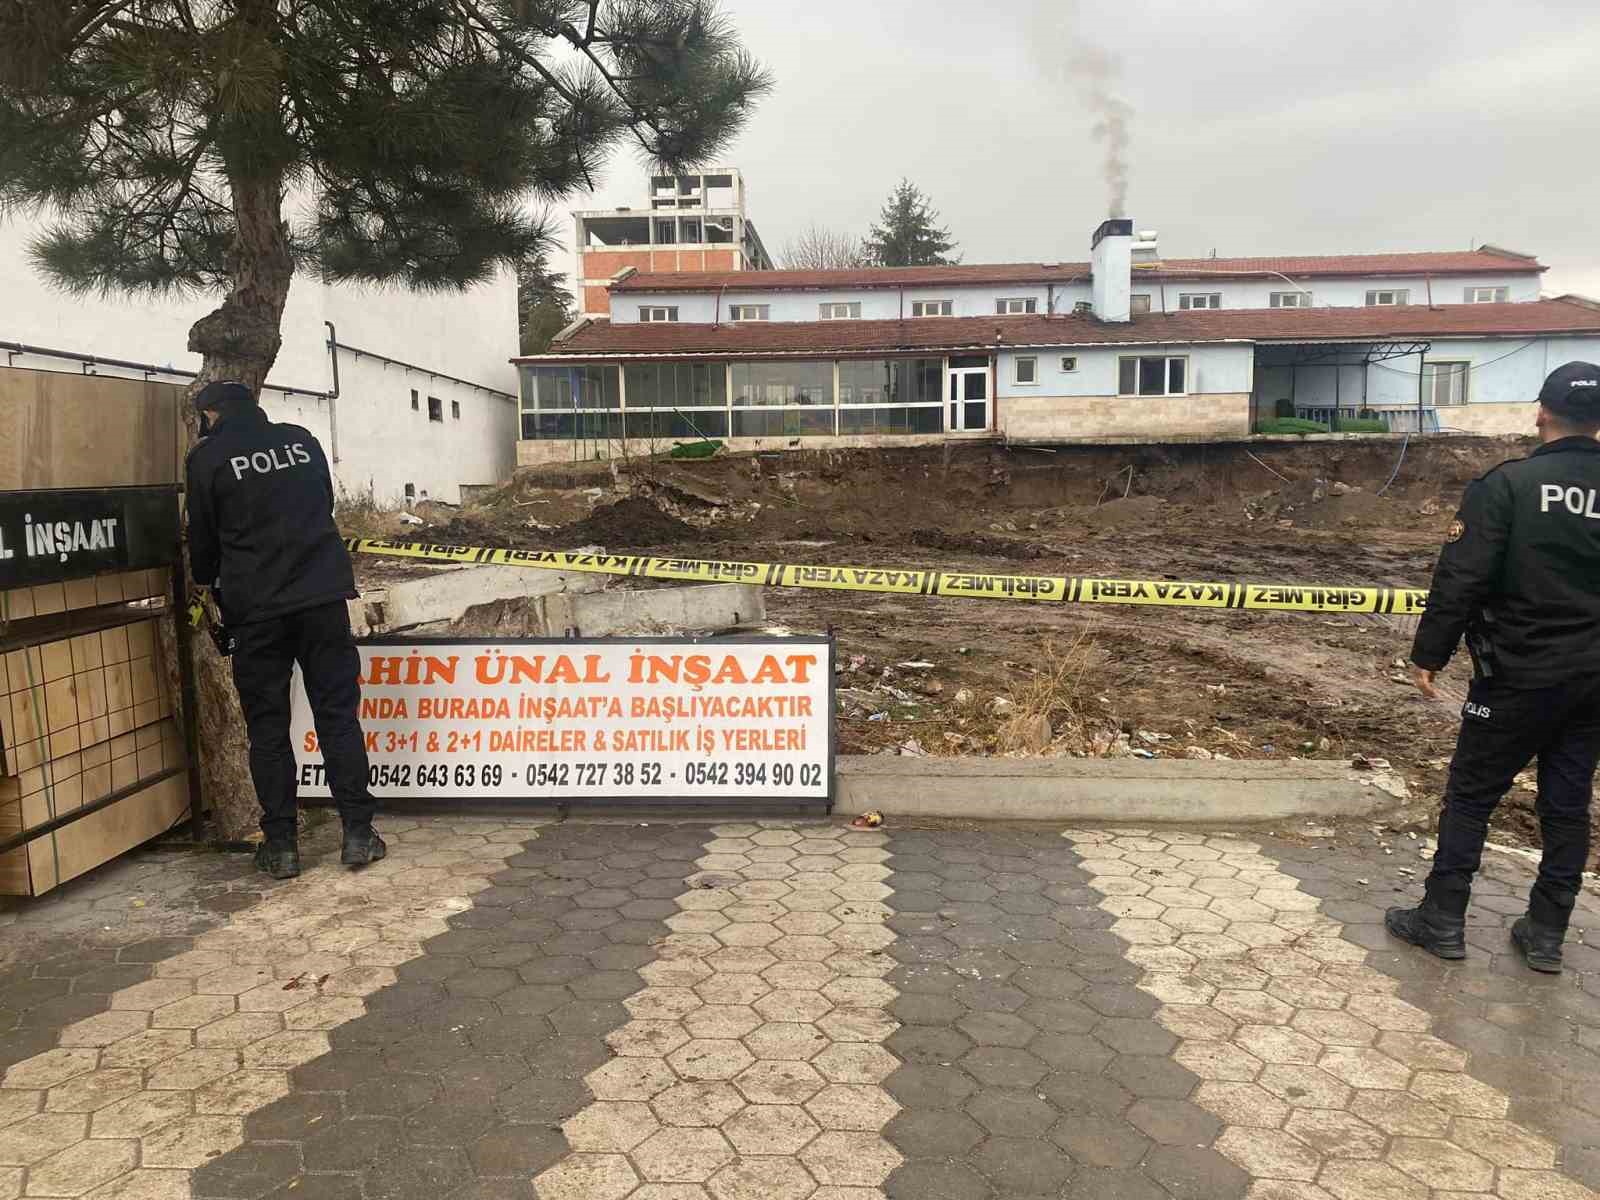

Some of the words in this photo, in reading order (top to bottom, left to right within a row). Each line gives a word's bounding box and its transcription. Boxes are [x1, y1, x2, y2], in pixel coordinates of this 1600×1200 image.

[25, 513, 117, 562] İNŞAAT
[564, 554, 627, 568] KAZA
[655, 559, 759, 581] GİRİLMEZ
[794, 566, 850, 585] YERİ
[852, 570, 918, 588] KAZA
[946, 575, 1055, 598] GİRİLMEZ
[1091, 581, 1150, 600] YERİ
[1153, 584, 1224, 602] KAZA
[1253, 587, 1367, 610] GİRİLMEZ
[475, 649, 611, 685] ÜNAL
[627, 648, 817, 691] İNŞAAT
[417, 698, 511, 719] BURADA
[631, 695, 813, 723] BAŞLIYACAKTIR
[385, 730, 418, 752] 3+1
[426, 731, 440, 752] &
[447, 730, 482, 752] 2+1
[489, 725, 587, 753] DAİRELER
[593, 730, 607, 752] &
[612, 729, 690, 752] SATILIK
[696, 724, 716, 757] İŞ
[722, 724, 807, 751] YERLERİ
[369, 764, 410, 788] 0542
[416, 764, 449, 787] 643
[454, 764, 476, 787] 63
[481, 764, 502, 787] 69
[526, 763, 569, 787] 0542
[575, 763, 608, 786] 727
[613, 763, 634, 786] 38
[640, 762, 662, 786] 52
[685, 762, 728, 786] 0542
[734, 762, 767, 786] 394
[773, 763, 794, 786] 90
[800, 763, 822, 787] 02
